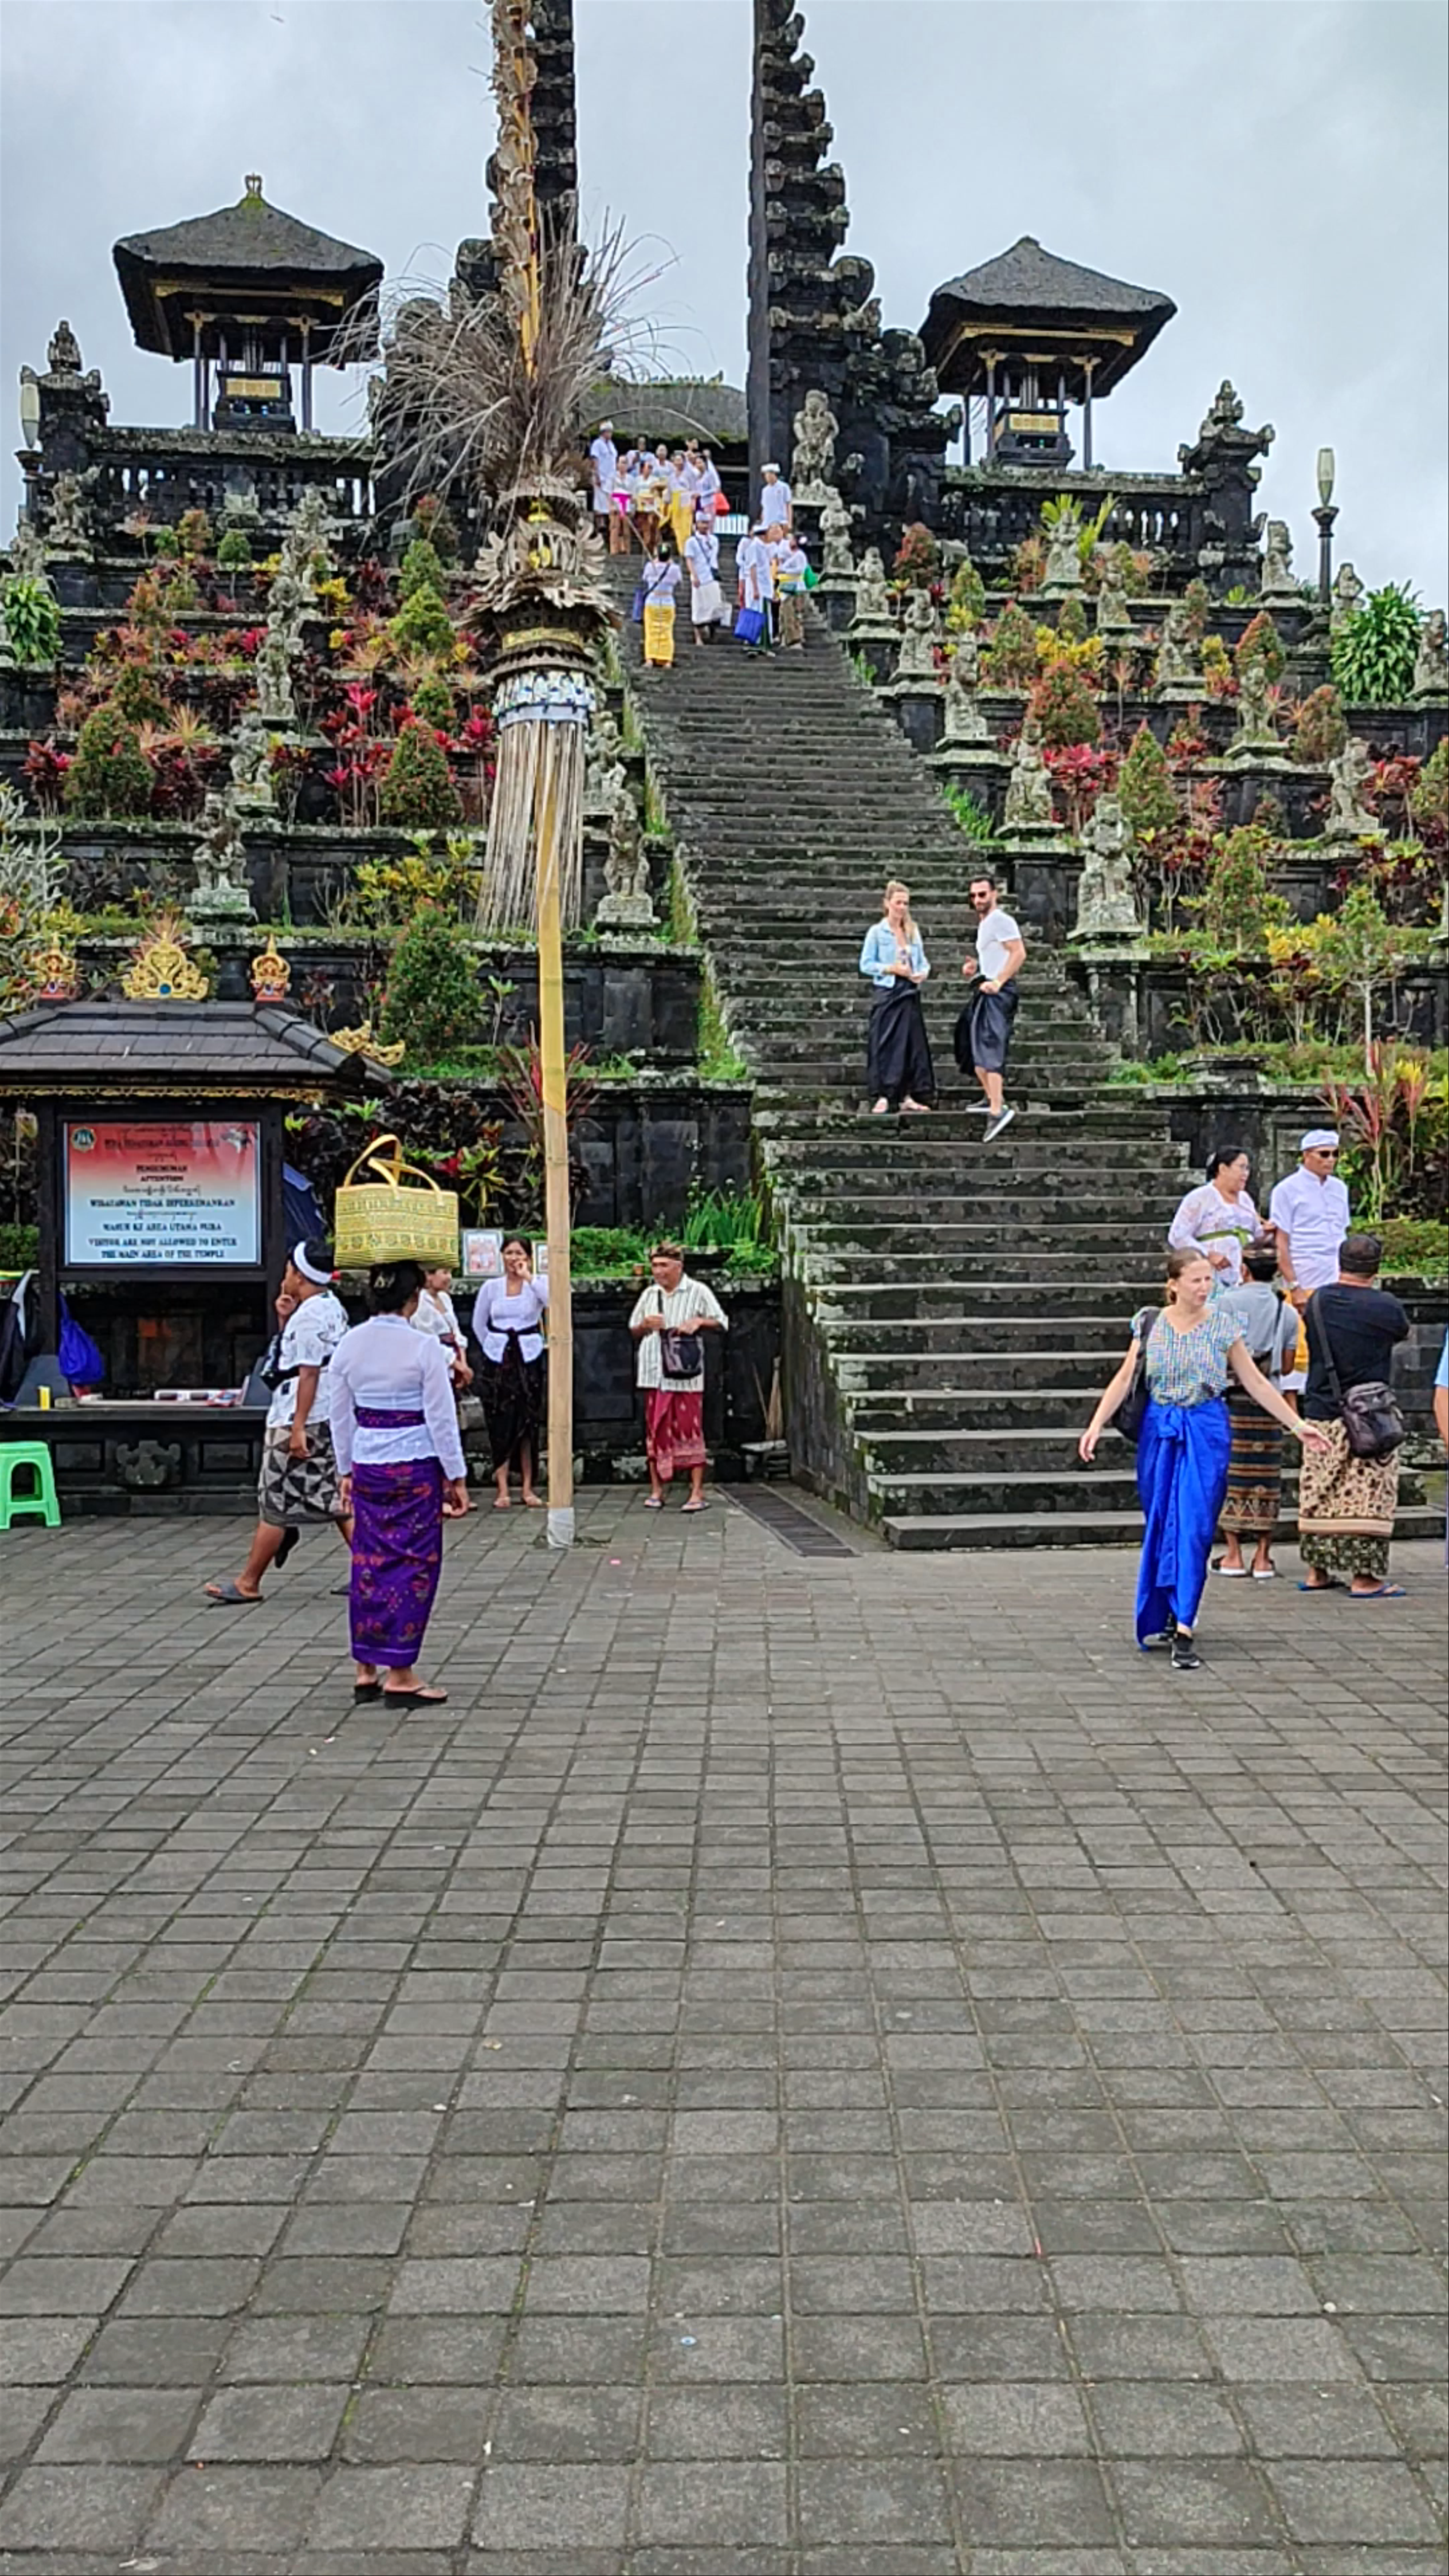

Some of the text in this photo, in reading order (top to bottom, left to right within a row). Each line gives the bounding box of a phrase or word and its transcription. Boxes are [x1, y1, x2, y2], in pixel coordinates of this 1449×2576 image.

[140, 1199, 163, 1207] TIDAK
[103, 1223, 130, 1231] MASUK
[133, 1223, 143, 1231] KE
[146, 1223, 167, 1231] AREA
[169, 1223, 197, 1231] UTAMA
[123, 1238, 137, 1246] ARE
[140, 1238, 156, 1246] NOT
[158, 1238, 196, 1246] ALLOWED
[199, 1238, 209, 1246] TO
[211, 1238, 237, 1246] ENTER
[102, 1250, 224, 1258] THE MAIN AREA OF THE TEMPLE
